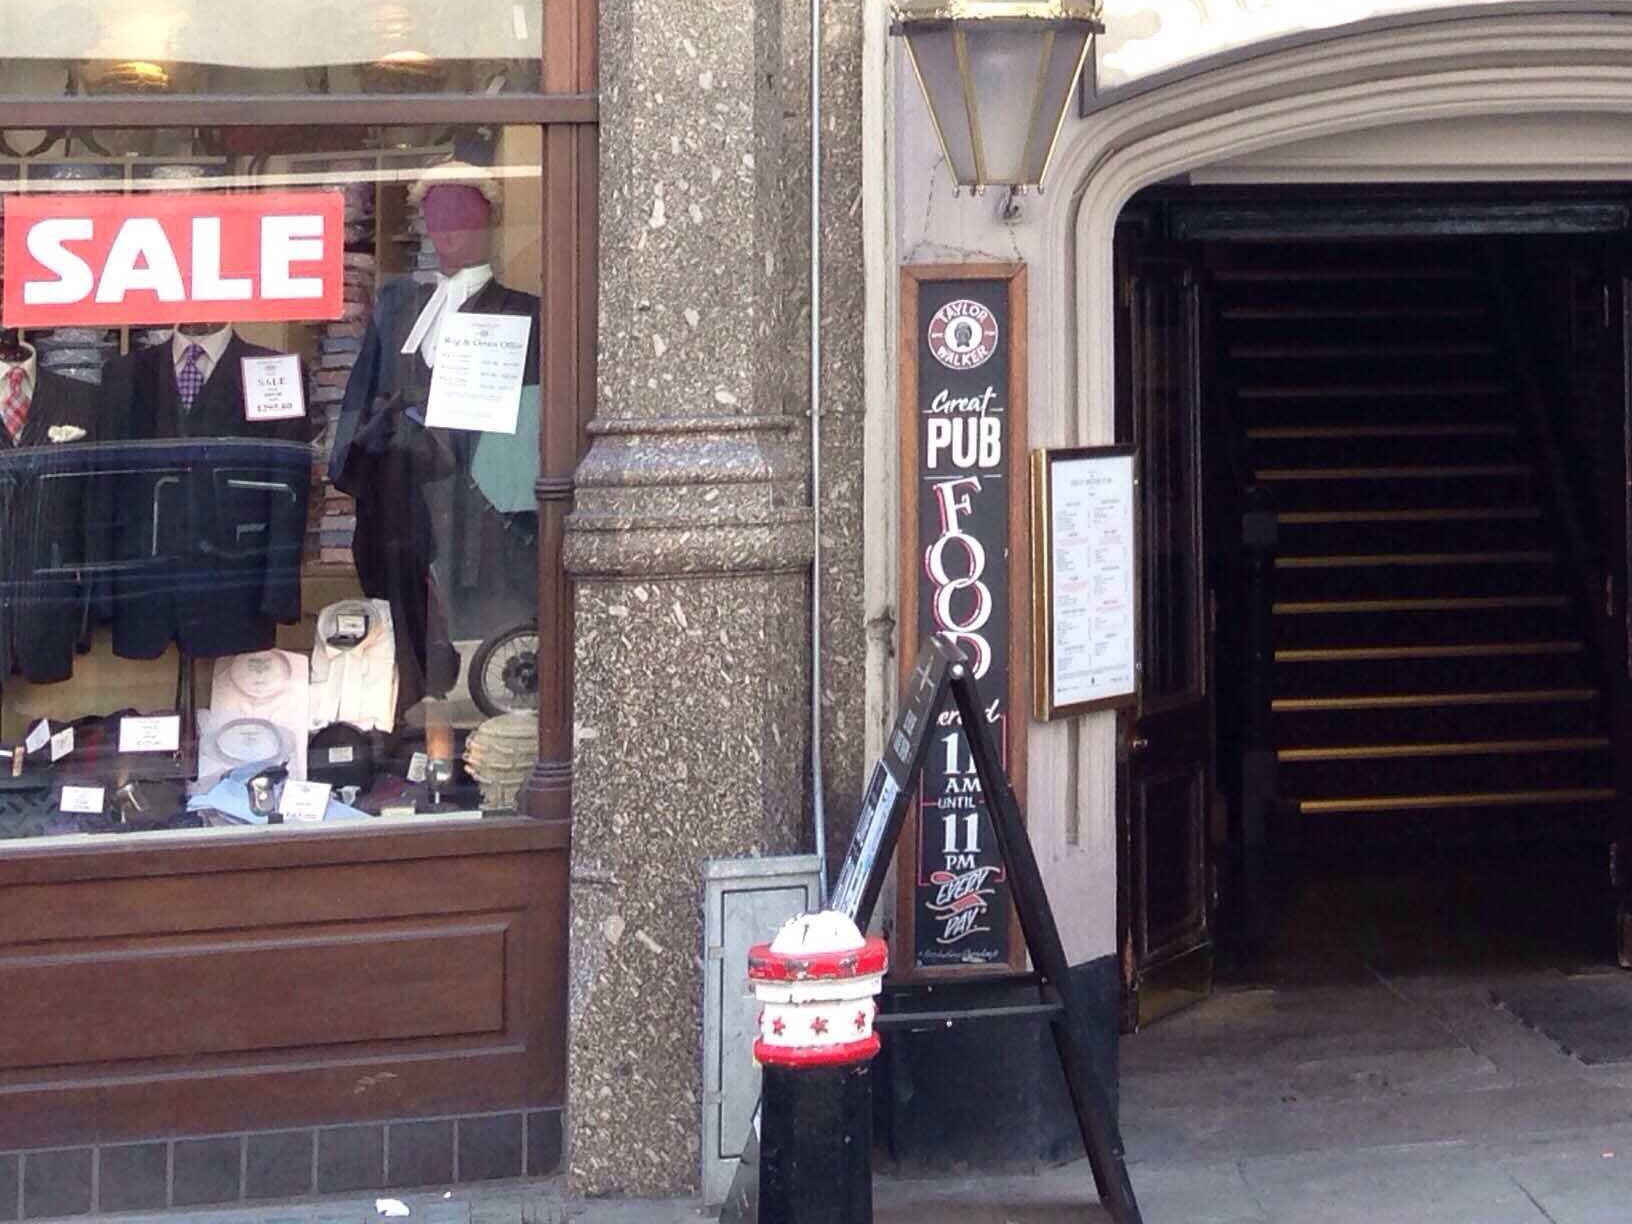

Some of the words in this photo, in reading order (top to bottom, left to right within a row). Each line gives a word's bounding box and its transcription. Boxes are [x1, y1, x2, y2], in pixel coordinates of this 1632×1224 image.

[24, 215, 325, 305] SALE
[937, 302, 988, 323] TAYLOR
[936, 345, 988, 366] WALKER
[931, 386, 997, 418] Great
[927, 417, 1001, 469] PUB
[929, 476, 993, 680] FOOD
[945, 778, 982, 793] AM
[937, 798, 976, 810] UNTIL
[941, 813, 982, 853] 11
[946, 855, 976, 870] PM
[936, 873, 990, 905] EVERY
